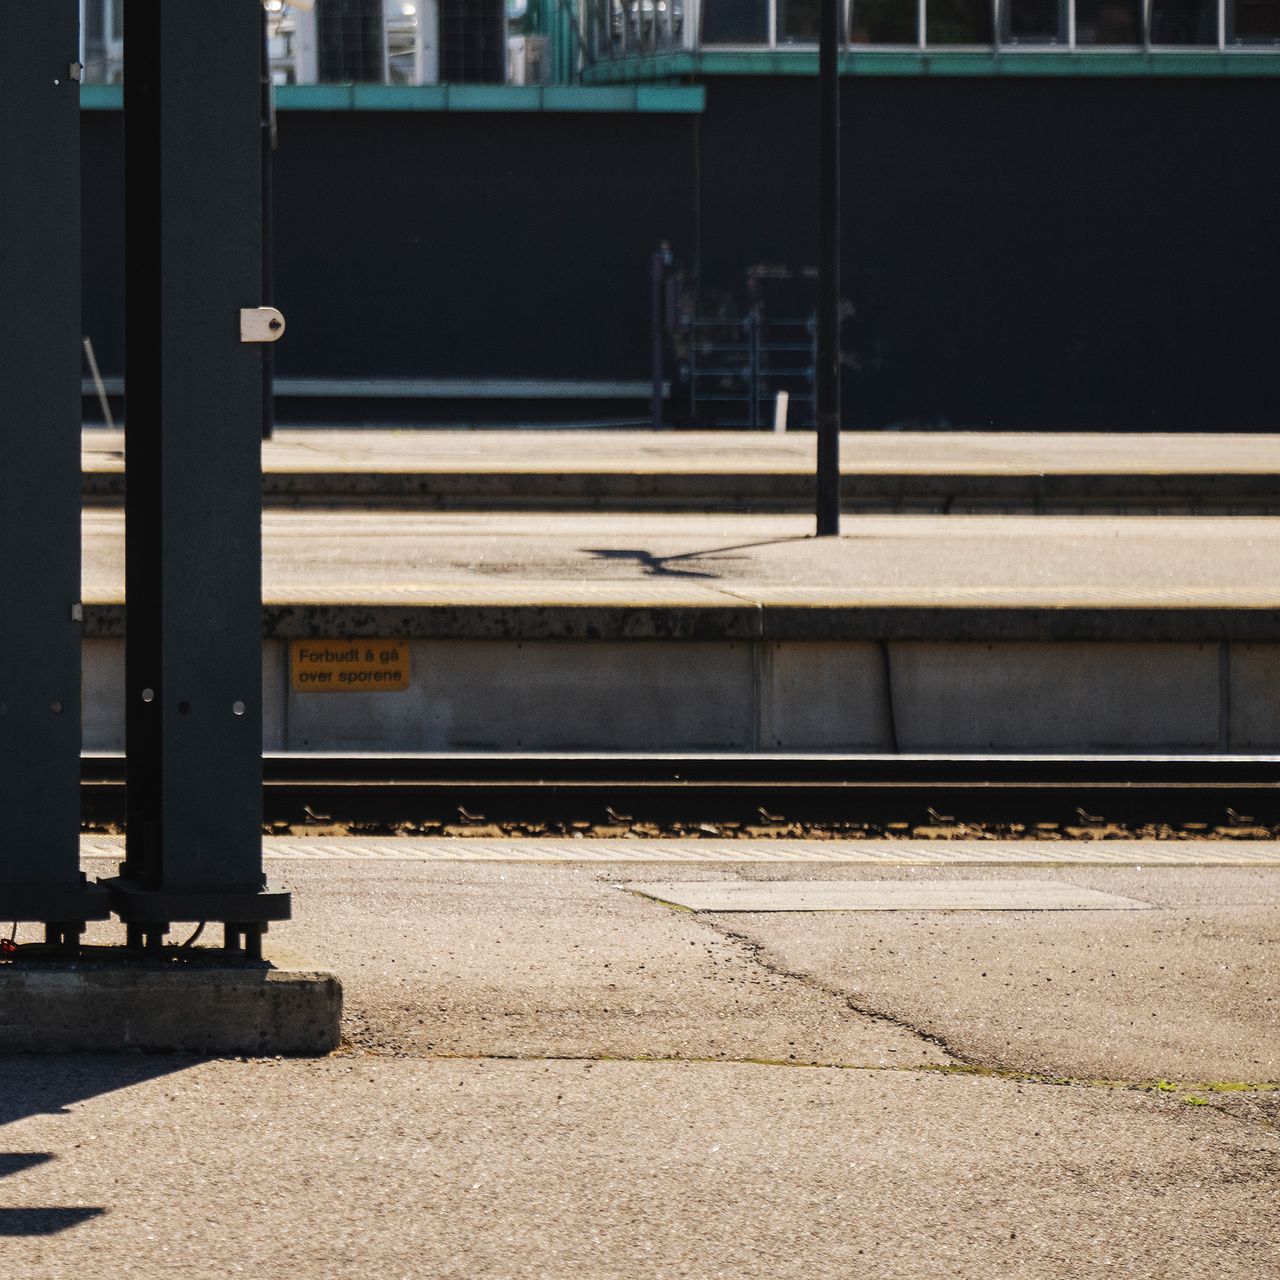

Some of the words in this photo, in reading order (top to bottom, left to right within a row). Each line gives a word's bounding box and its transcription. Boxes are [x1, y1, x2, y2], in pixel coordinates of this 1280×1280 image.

[299, 649, 359, 663] Forbudt
[364, 648, 374, 663] å
[380, 648, 400, 665] gå
[298, 671, 333, 683] over
[338, 669, 402, 685] sporene
